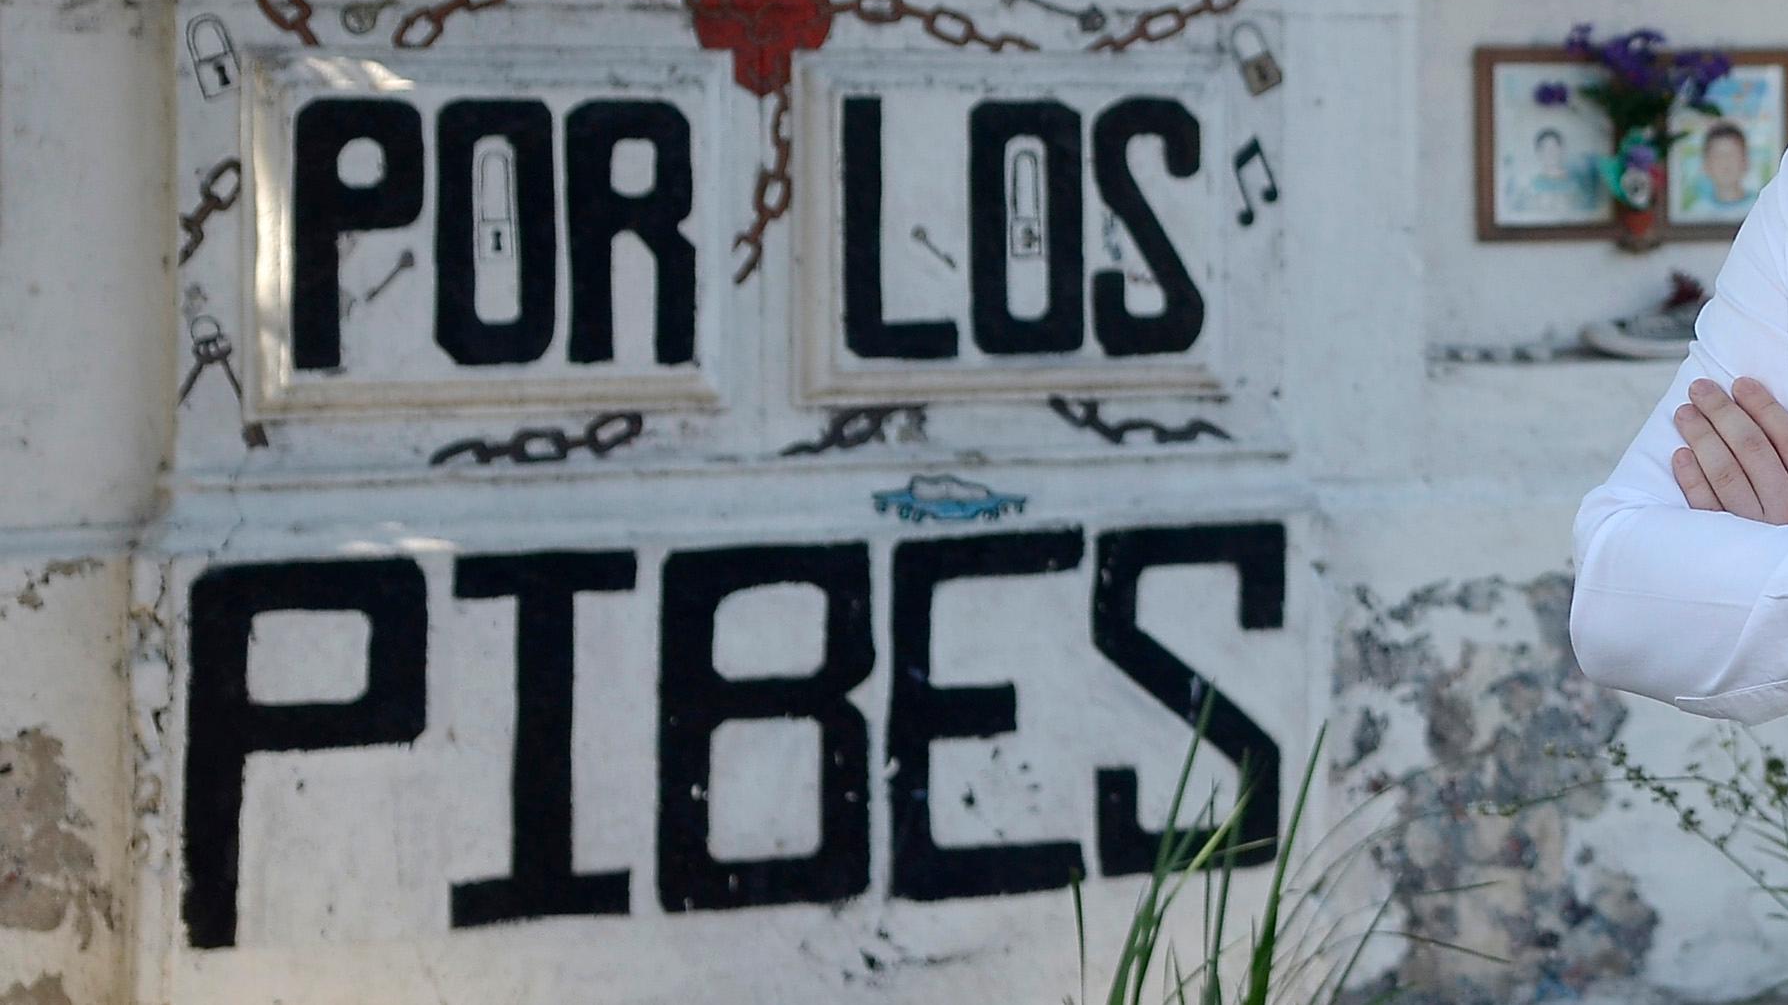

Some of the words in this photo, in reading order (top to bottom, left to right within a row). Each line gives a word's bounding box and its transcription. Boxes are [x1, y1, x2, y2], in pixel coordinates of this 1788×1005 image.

[290, 97, 697, 372] POR
[840, 96, 1205, 360] LOS
[182, 521, 1288, 949] PIBES
